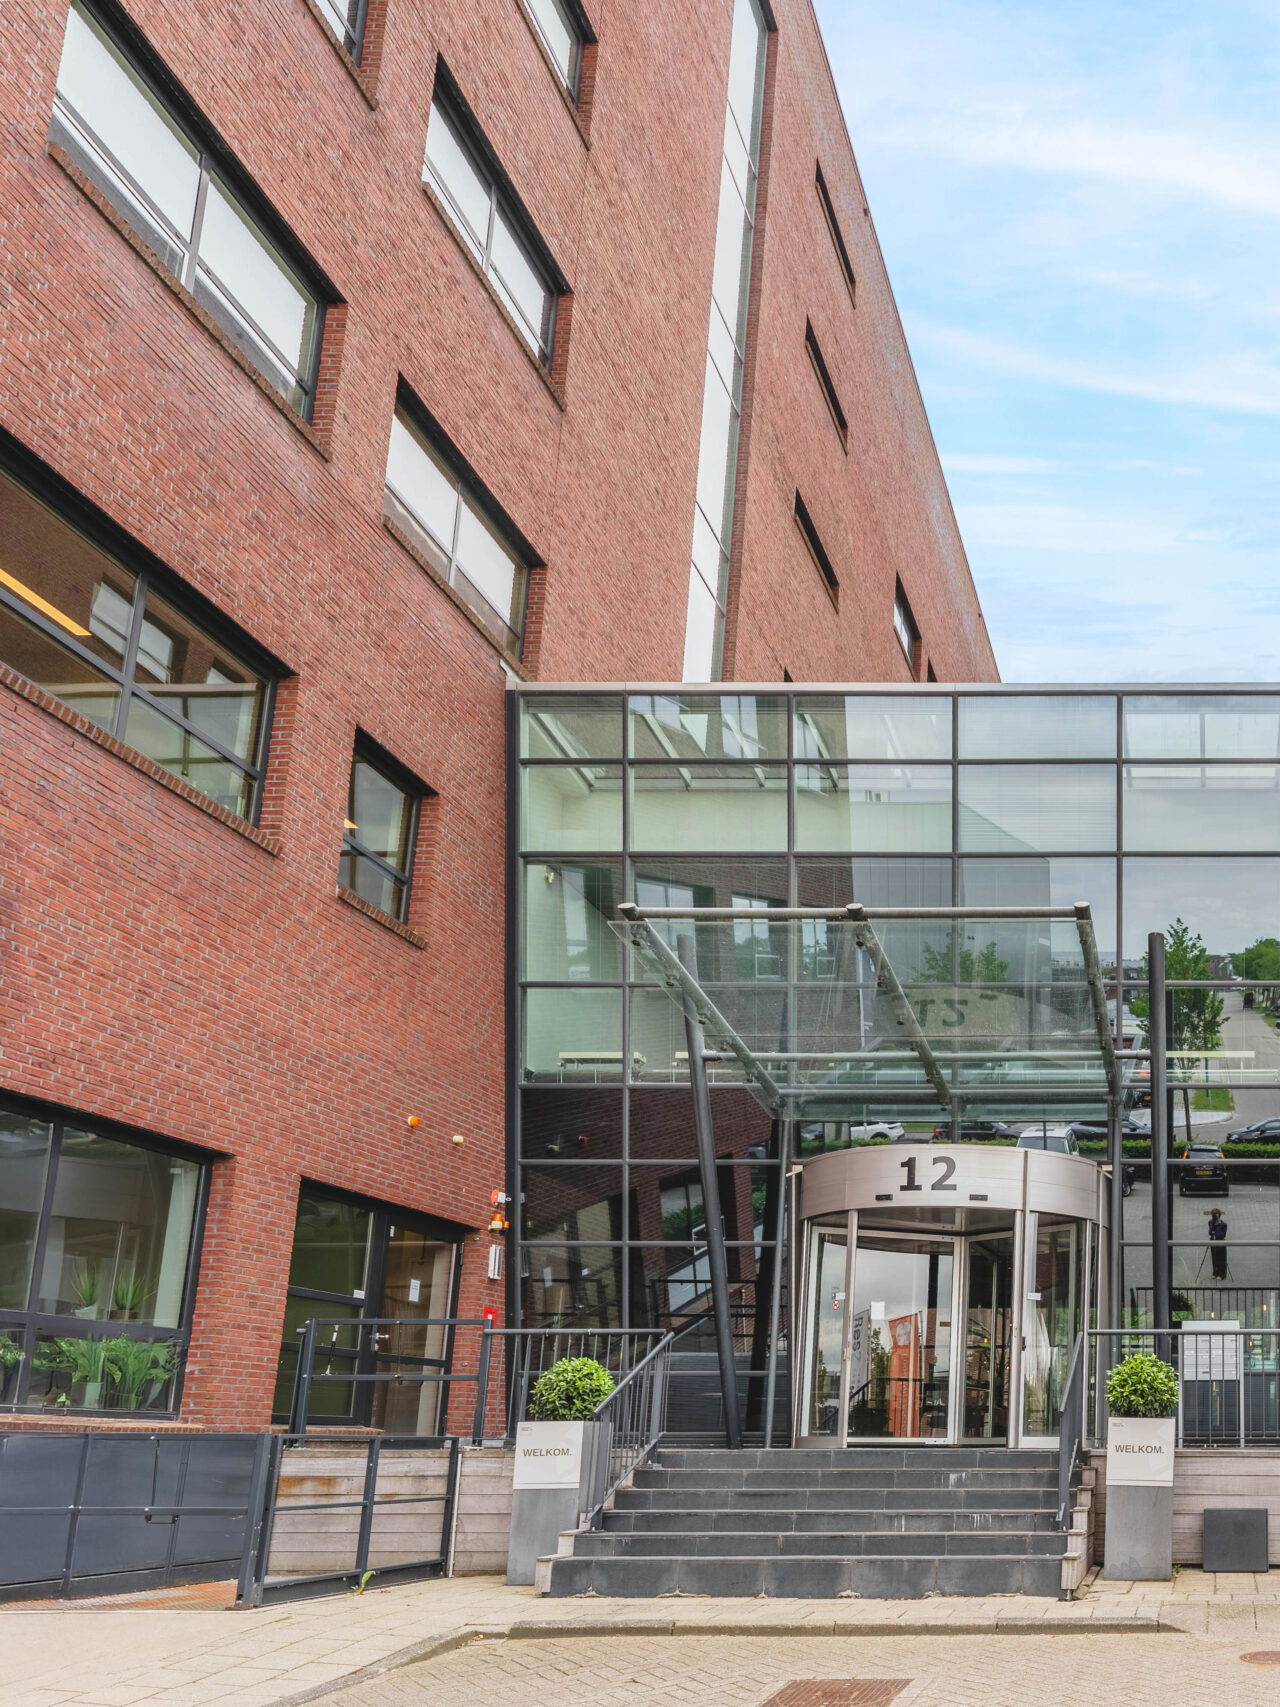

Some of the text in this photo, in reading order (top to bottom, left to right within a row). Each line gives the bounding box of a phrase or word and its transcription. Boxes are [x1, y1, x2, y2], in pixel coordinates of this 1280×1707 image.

[899, 1156, 957, 1191] 12
[522, 1448, 572, 1457] WELKOM.
[1114, 1444, 1165, 1454] WELKOM.
